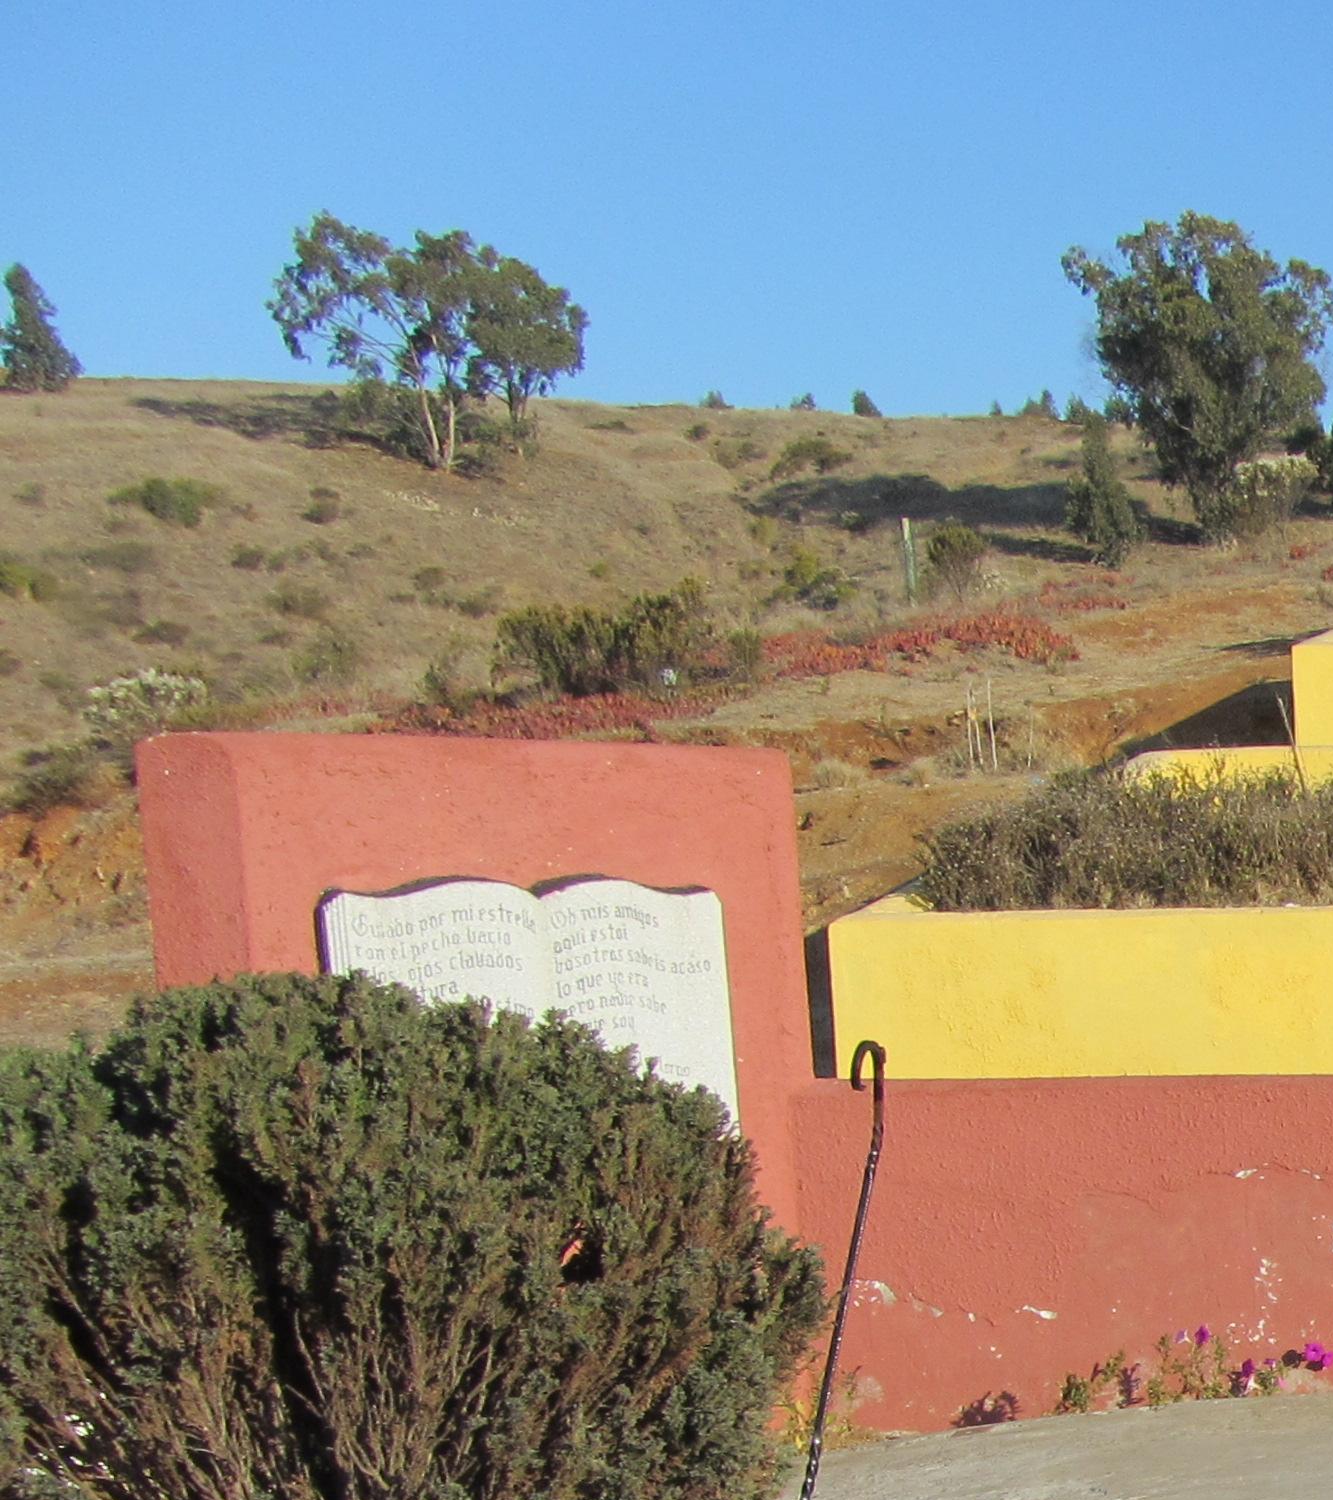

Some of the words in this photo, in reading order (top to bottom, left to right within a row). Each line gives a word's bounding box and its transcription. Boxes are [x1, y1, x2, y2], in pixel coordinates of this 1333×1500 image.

[418, 912, 445, 935] por
[580, 903, 610, 922] mis
[613, 903, 660, 930] amigos
[407, 960, 443, 984] ojos
[556, 980, 572, 1000] lo
[575, 973, 603, 996] que
